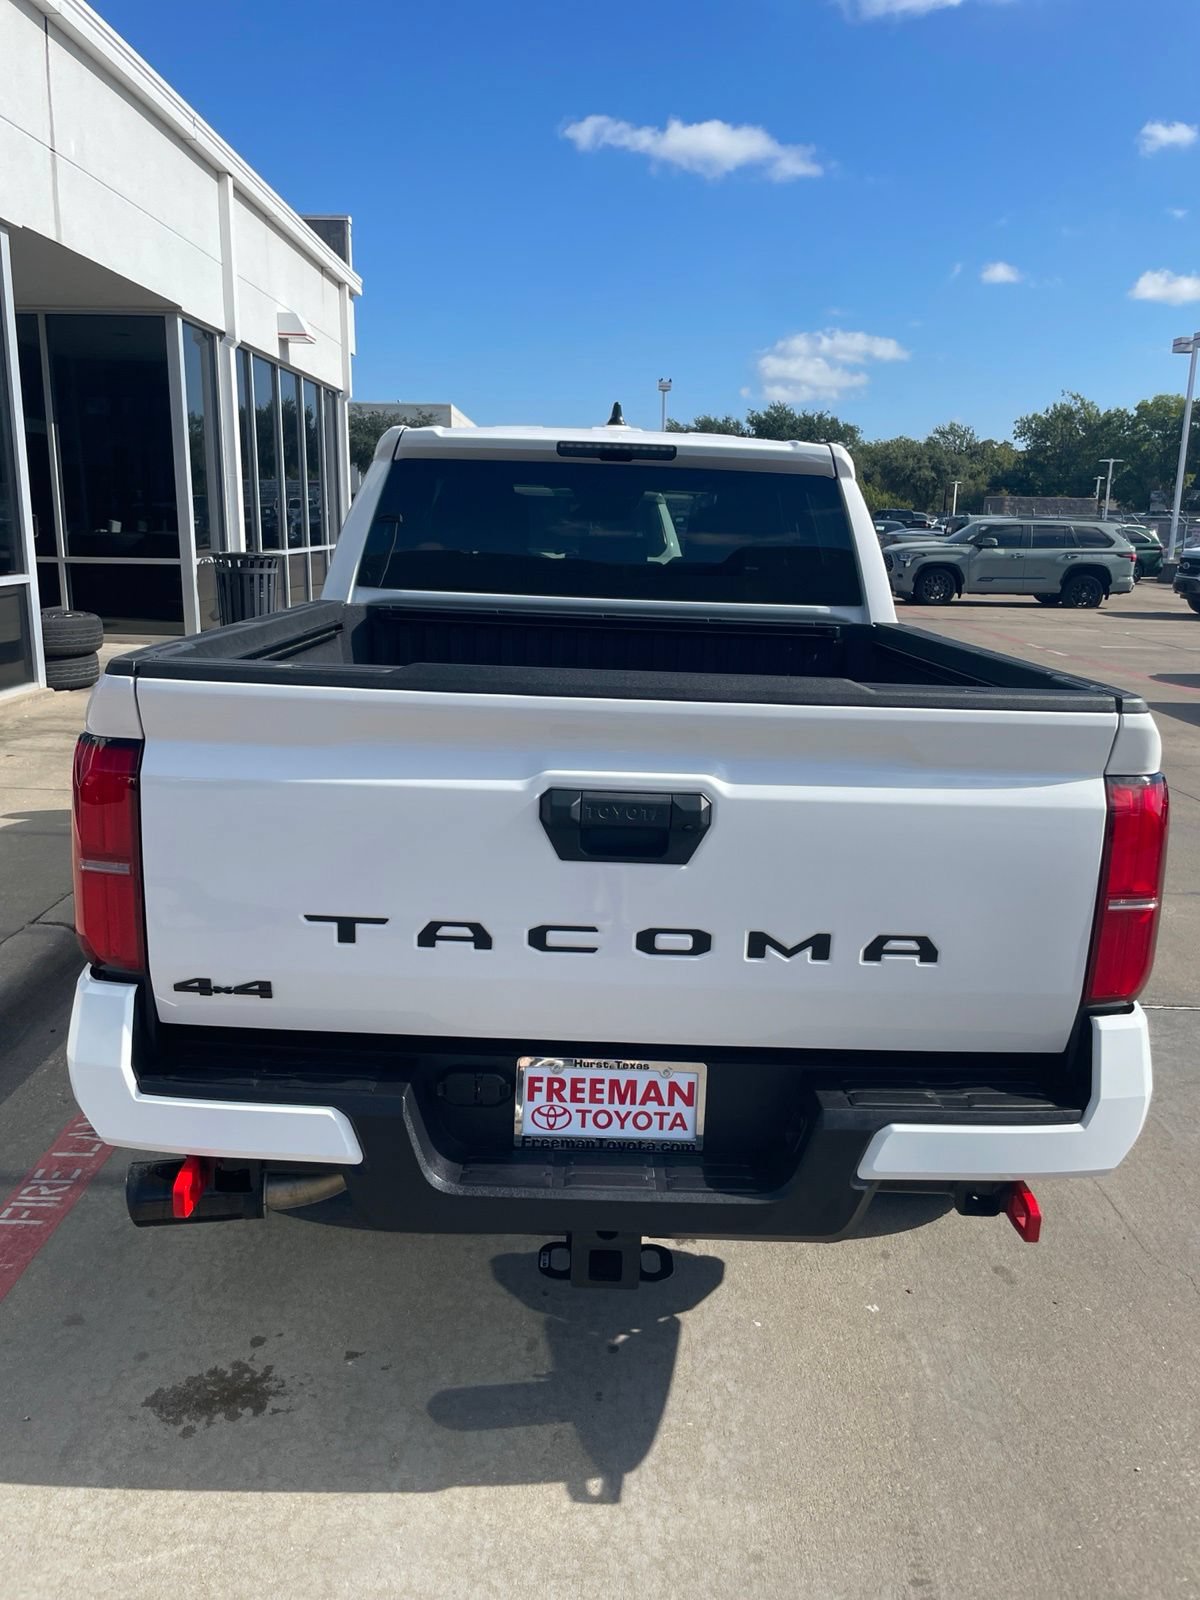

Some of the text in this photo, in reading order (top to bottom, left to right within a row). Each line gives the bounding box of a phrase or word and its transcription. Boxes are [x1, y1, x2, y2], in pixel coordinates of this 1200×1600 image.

[304, 914, 938, 964] TACOMA
[615, 1061, 650, 1071] Texas
[527, 1076, 695, 1107] FREEMAN
[575, 1109, 689, 1131] TOYOTA
[522, 1135, 696, 1152] FreemanToyota.com
[0, 1168, 82, 1225] FIRE
